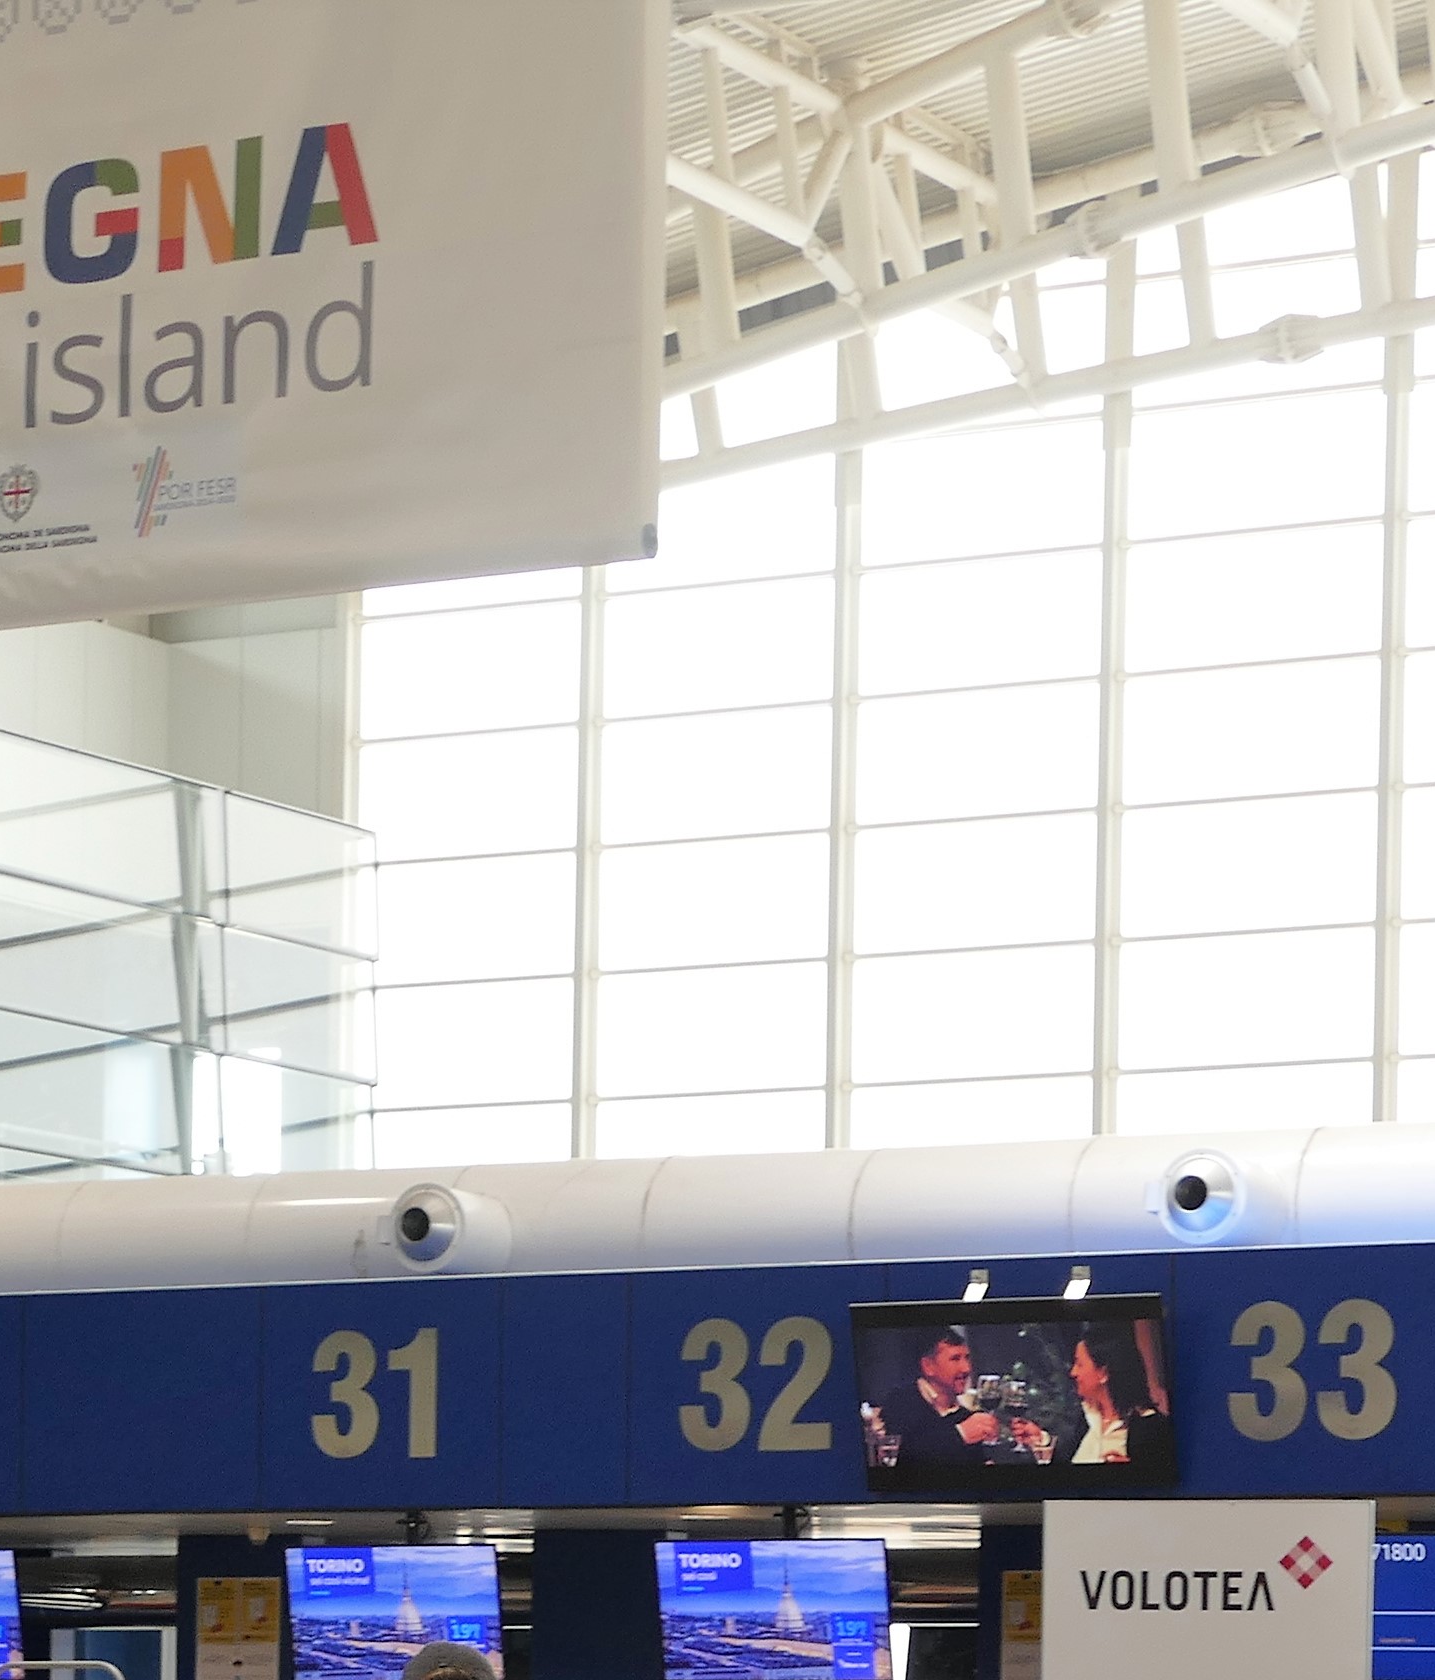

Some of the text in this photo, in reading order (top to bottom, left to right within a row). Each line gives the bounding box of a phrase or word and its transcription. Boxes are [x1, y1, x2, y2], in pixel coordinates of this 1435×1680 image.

[22, 260, 374, 431] island
[310, 1327, 438, 1460] 31
[678, 1316, 833, 1453] 32
[1227, 1298, 1397, 1442] 33
[306, 1558, 365, 1574] TORINO
[678, 1553, 742, 1569] TORINO
[1080, 1570, 1275, 1611] VOLOTEA
